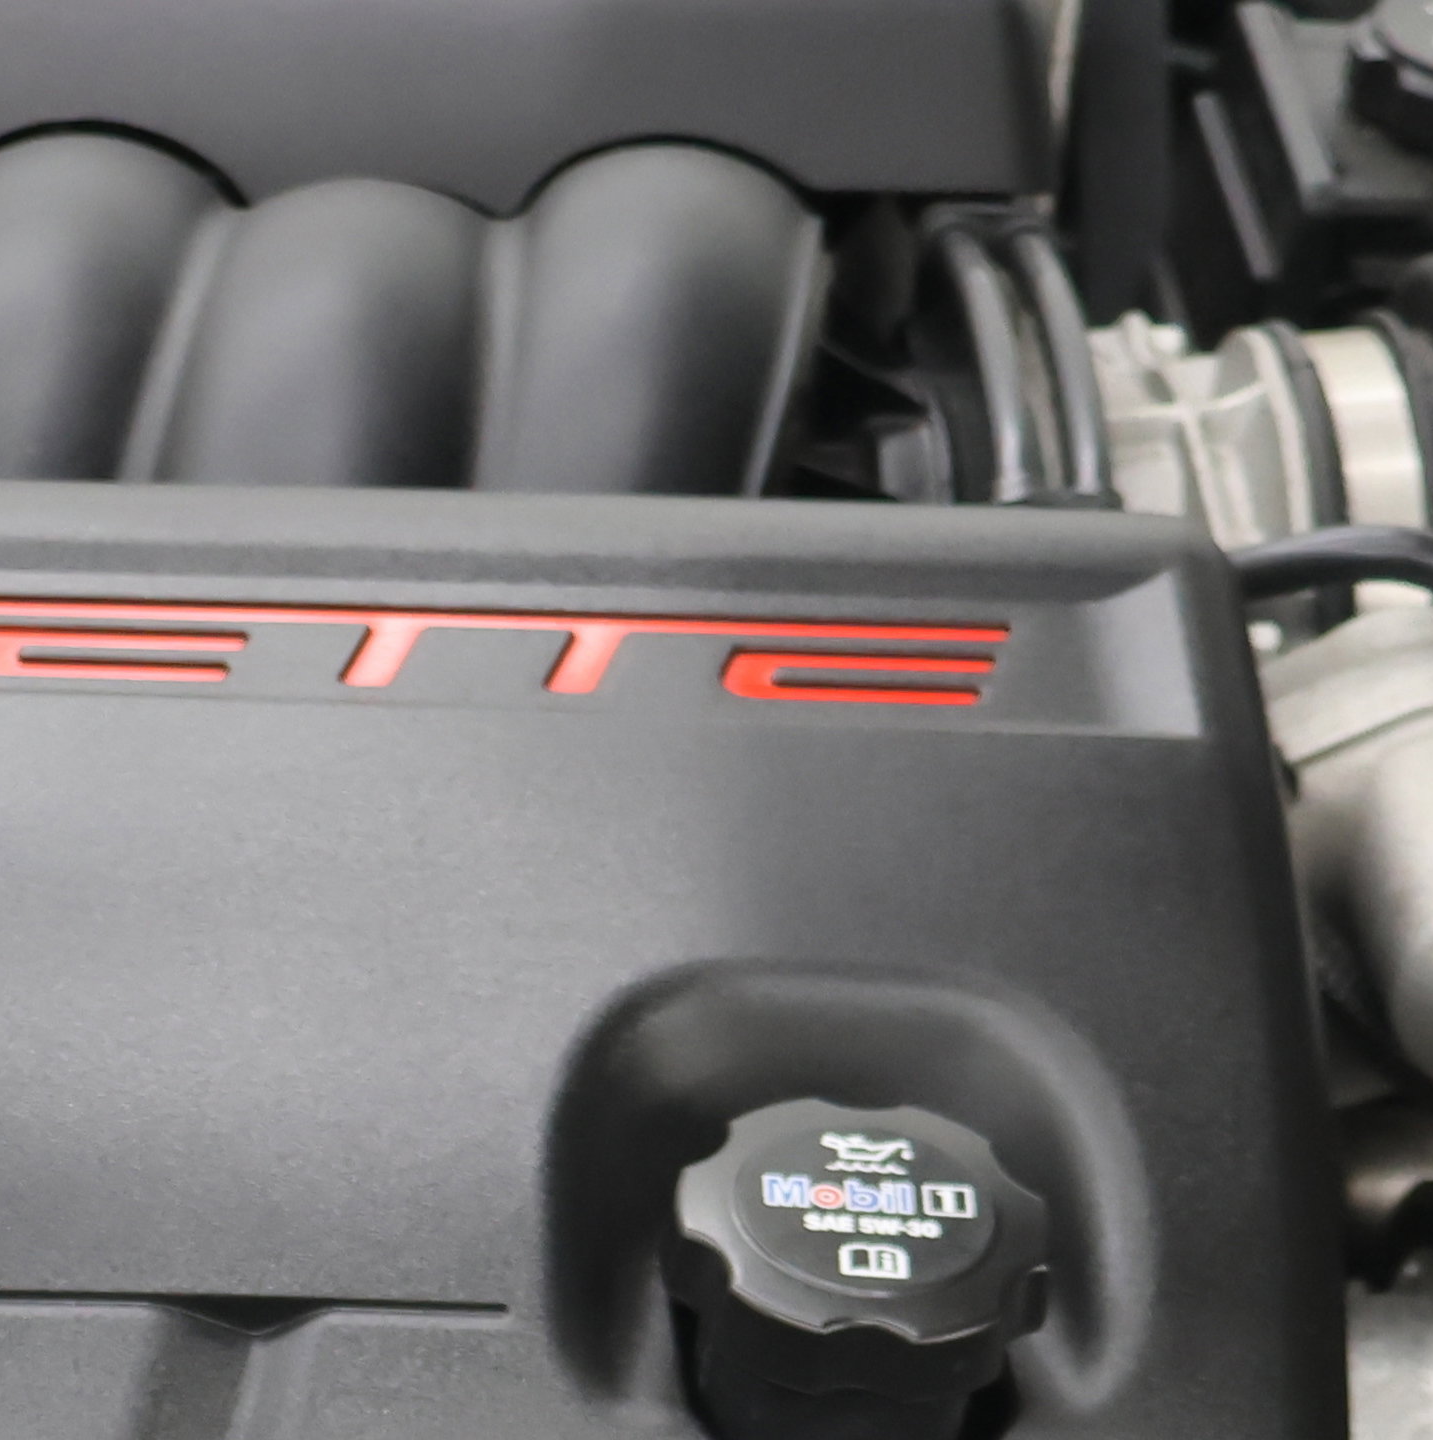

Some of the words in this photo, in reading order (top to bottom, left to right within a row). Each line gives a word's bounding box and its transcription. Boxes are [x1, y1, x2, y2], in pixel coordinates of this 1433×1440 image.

[761, 1172, 917, 1216] Mobil
[803, 1212, 855, 1233] SAE
[858, 1214, 943, 1238] 5W-30
